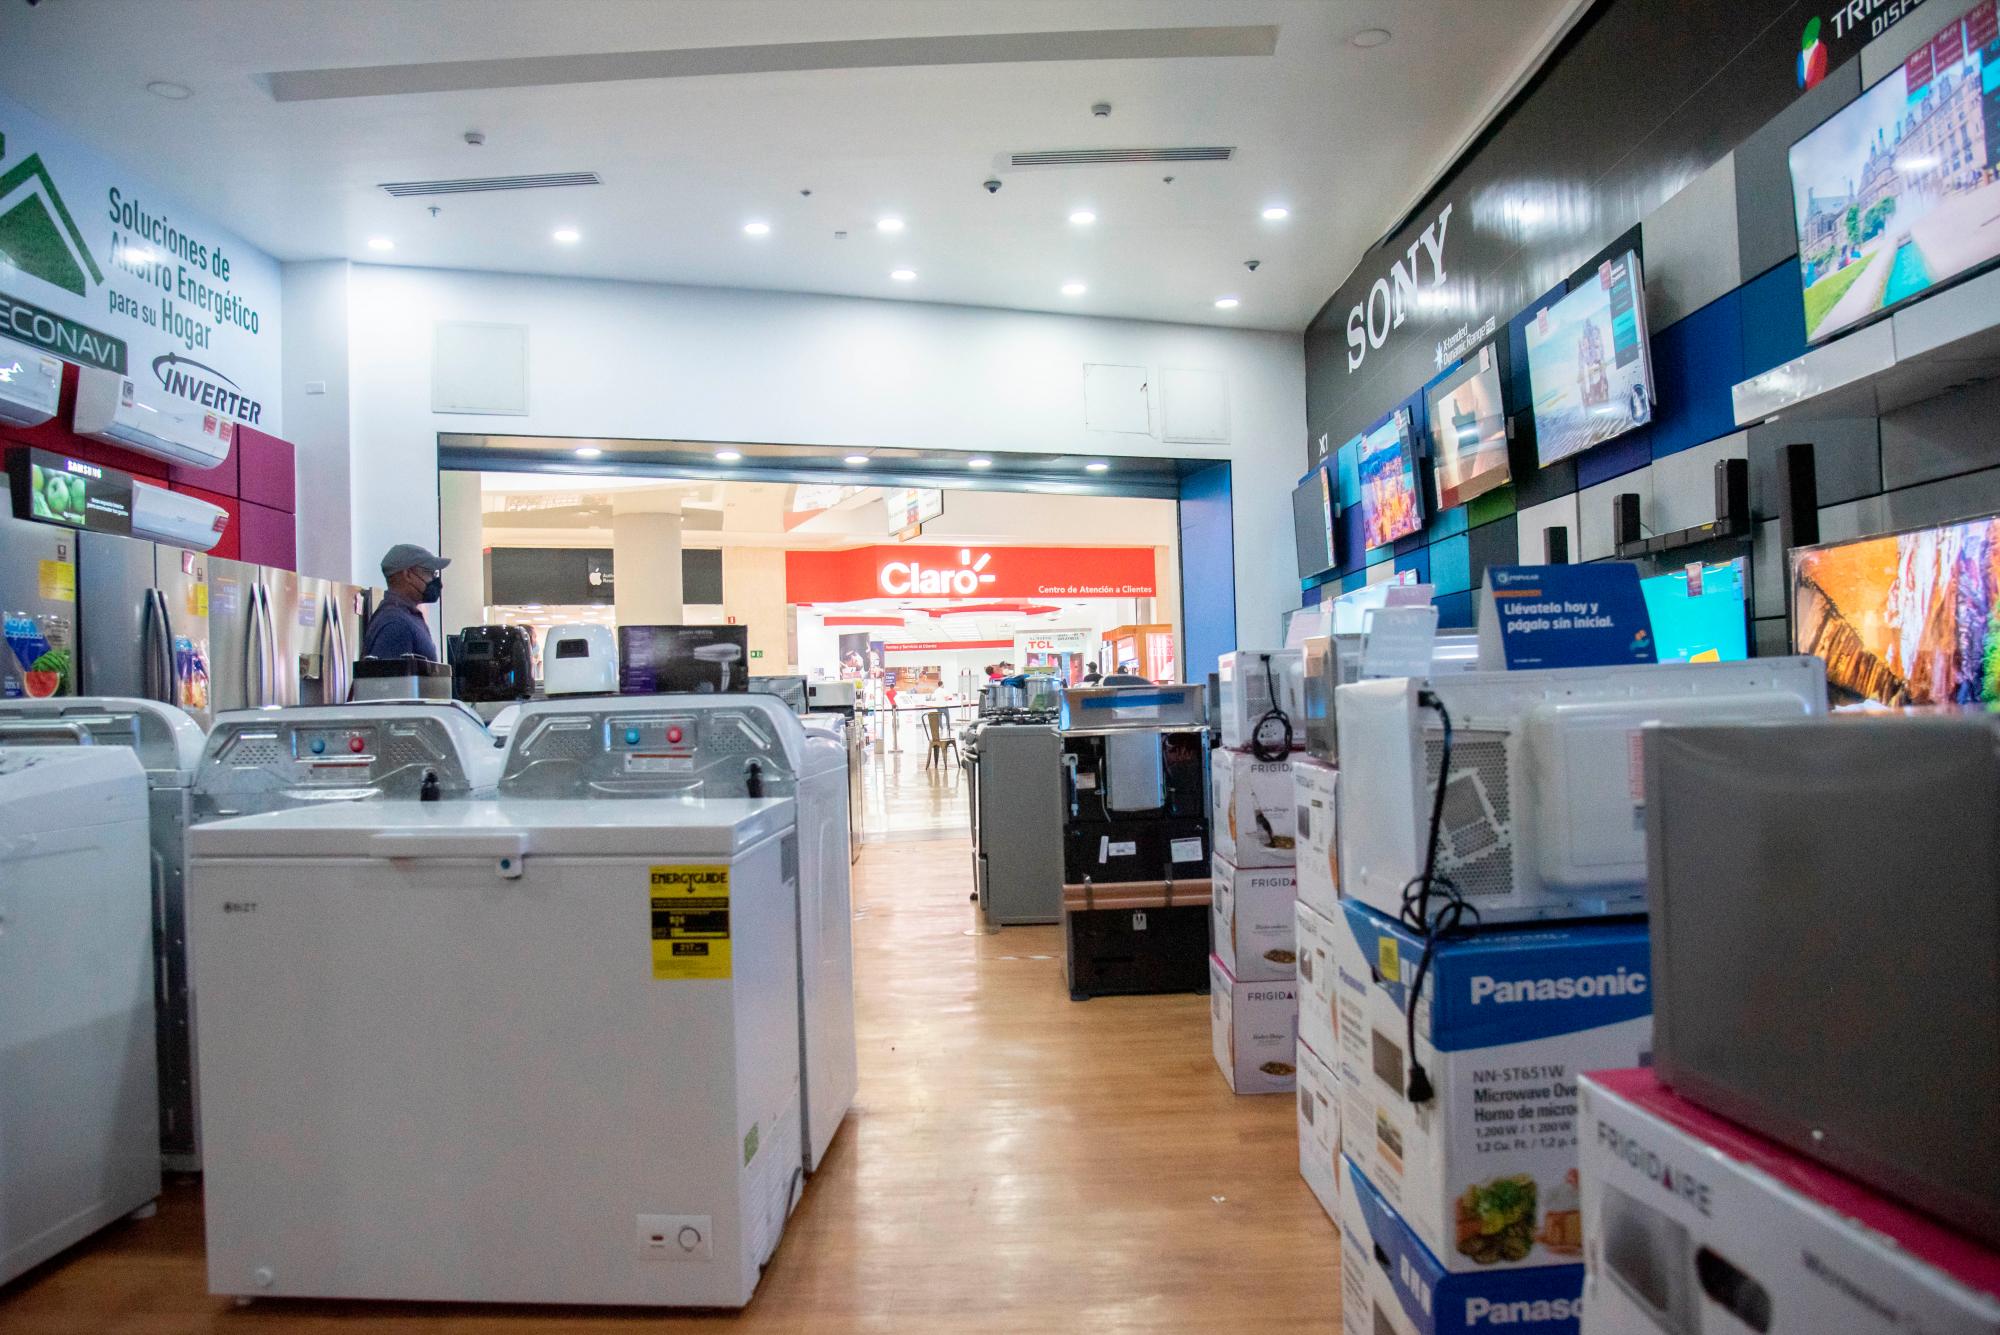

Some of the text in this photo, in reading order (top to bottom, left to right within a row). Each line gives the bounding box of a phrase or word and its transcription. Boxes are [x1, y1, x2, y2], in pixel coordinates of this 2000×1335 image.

[109, 187, 230, 282] Soluciones de
[178, 265, 259, 334] Energético
[1347, 203, 1453, 374] SONY
[0, 299, 117, 367] ECONAVI
[109, 290, 211, 350] para su Hogar
[164, 368, 262, 425] INVERTER
[67, 459, 103, 479] SAMSUNG
[881, 562, 978, 595] Claro
[1038, 585, 1066, 594] Centro
[1067, 585, 1078, 593] de
[1080, 585, 1114, 593] Atención
[1122, 585, 1153, 593] Clientes
[1504, 601, 1599, 615] Llévatelo hoy y
[1507, 616, 1615, 633] págalo sin inicial.
[1028, 641, 1054, 649] TCL
[651, 872, 728, 884] ENERGYGUIDE
[1471, 966, 1647, 1005] Panasonic
[1473, 1065, 1564, 1082] NN-ST651W
[1474, 1087, 1550, 1103] Microwave
[1475, 1107, 1515, 1122] Horno
[1518, 1103, 1534, 1119] de
[1597, 1119, 1713, 1217] FRIGIDAIRE
